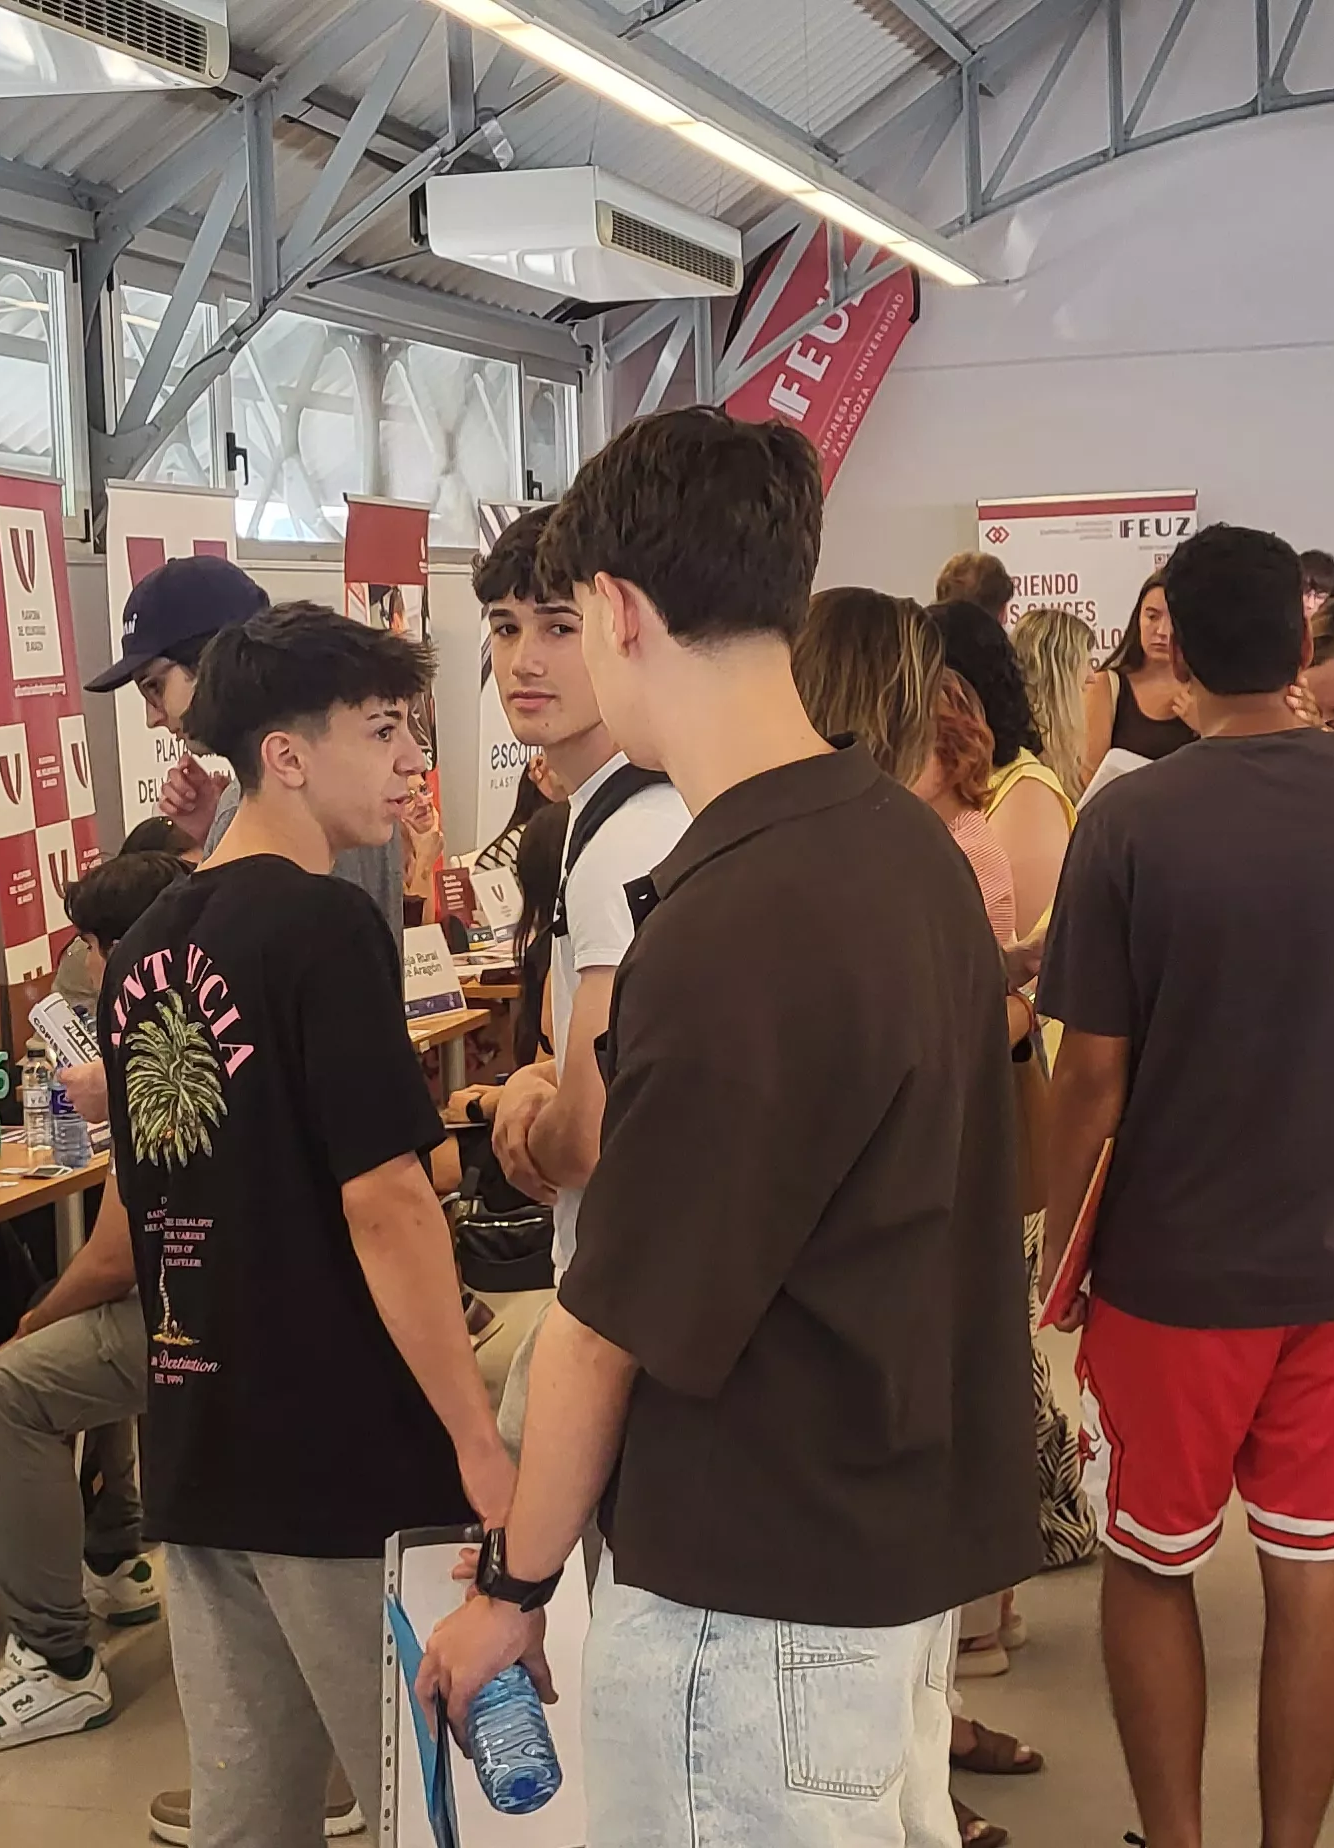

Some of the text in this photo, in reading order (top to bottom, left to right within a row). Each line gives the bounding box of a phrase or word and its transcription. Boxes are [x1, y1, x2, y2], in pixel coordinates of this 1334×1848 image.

[768, 263, 865, 421] FEU
[854, 293, 905, 381] UNIVERSIDAD
[1120, 517, 1191, 538] FEUZ
